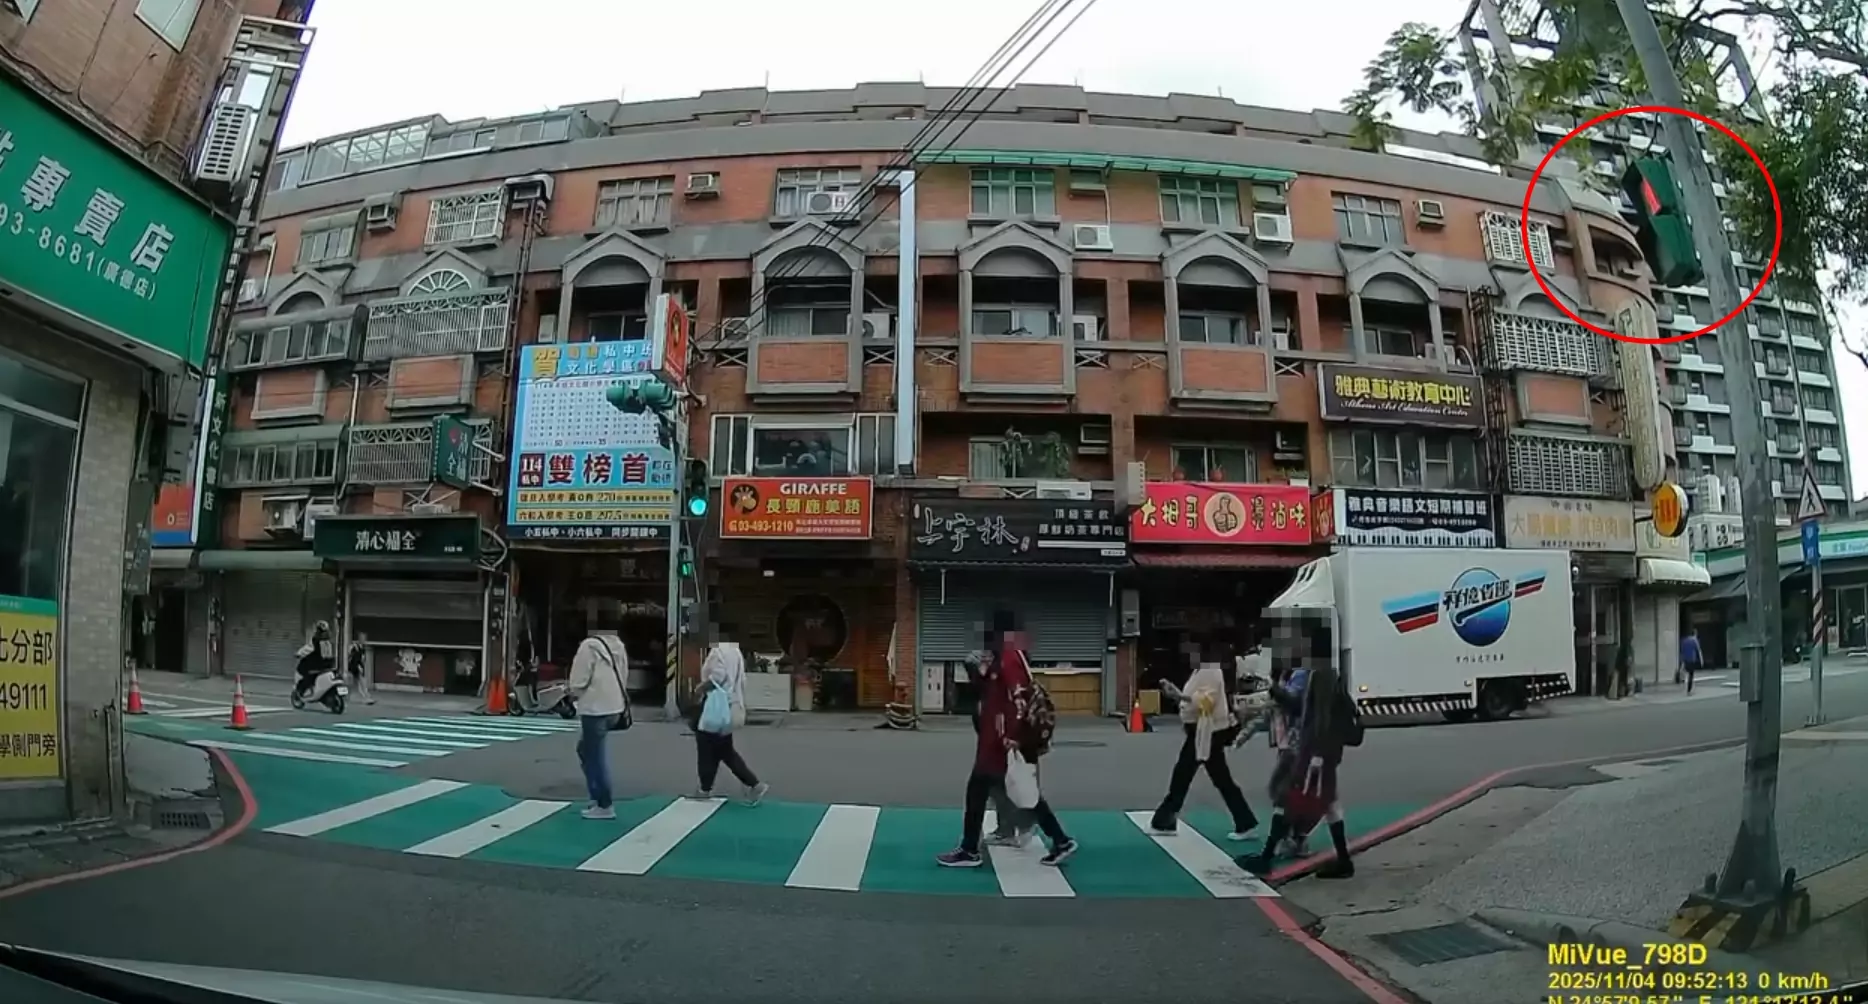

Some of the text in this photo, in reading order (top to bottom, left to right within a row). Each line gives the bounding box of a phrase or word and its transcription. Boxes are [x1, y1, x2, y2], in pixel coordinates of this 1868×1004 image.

[1335, 375, 1472, 407] 雅典藝術教育中心
[1378, 402, 1396, 411] Art
[521, 457, 542, 473] 114
[548, 453, 650, 484] 雙榜首
[780, 483, 847, 495] GIRAFFE
[766, 498, 860, 514] 長頸鹿美語
[738, 520, 794, 532] 03-493-1210
